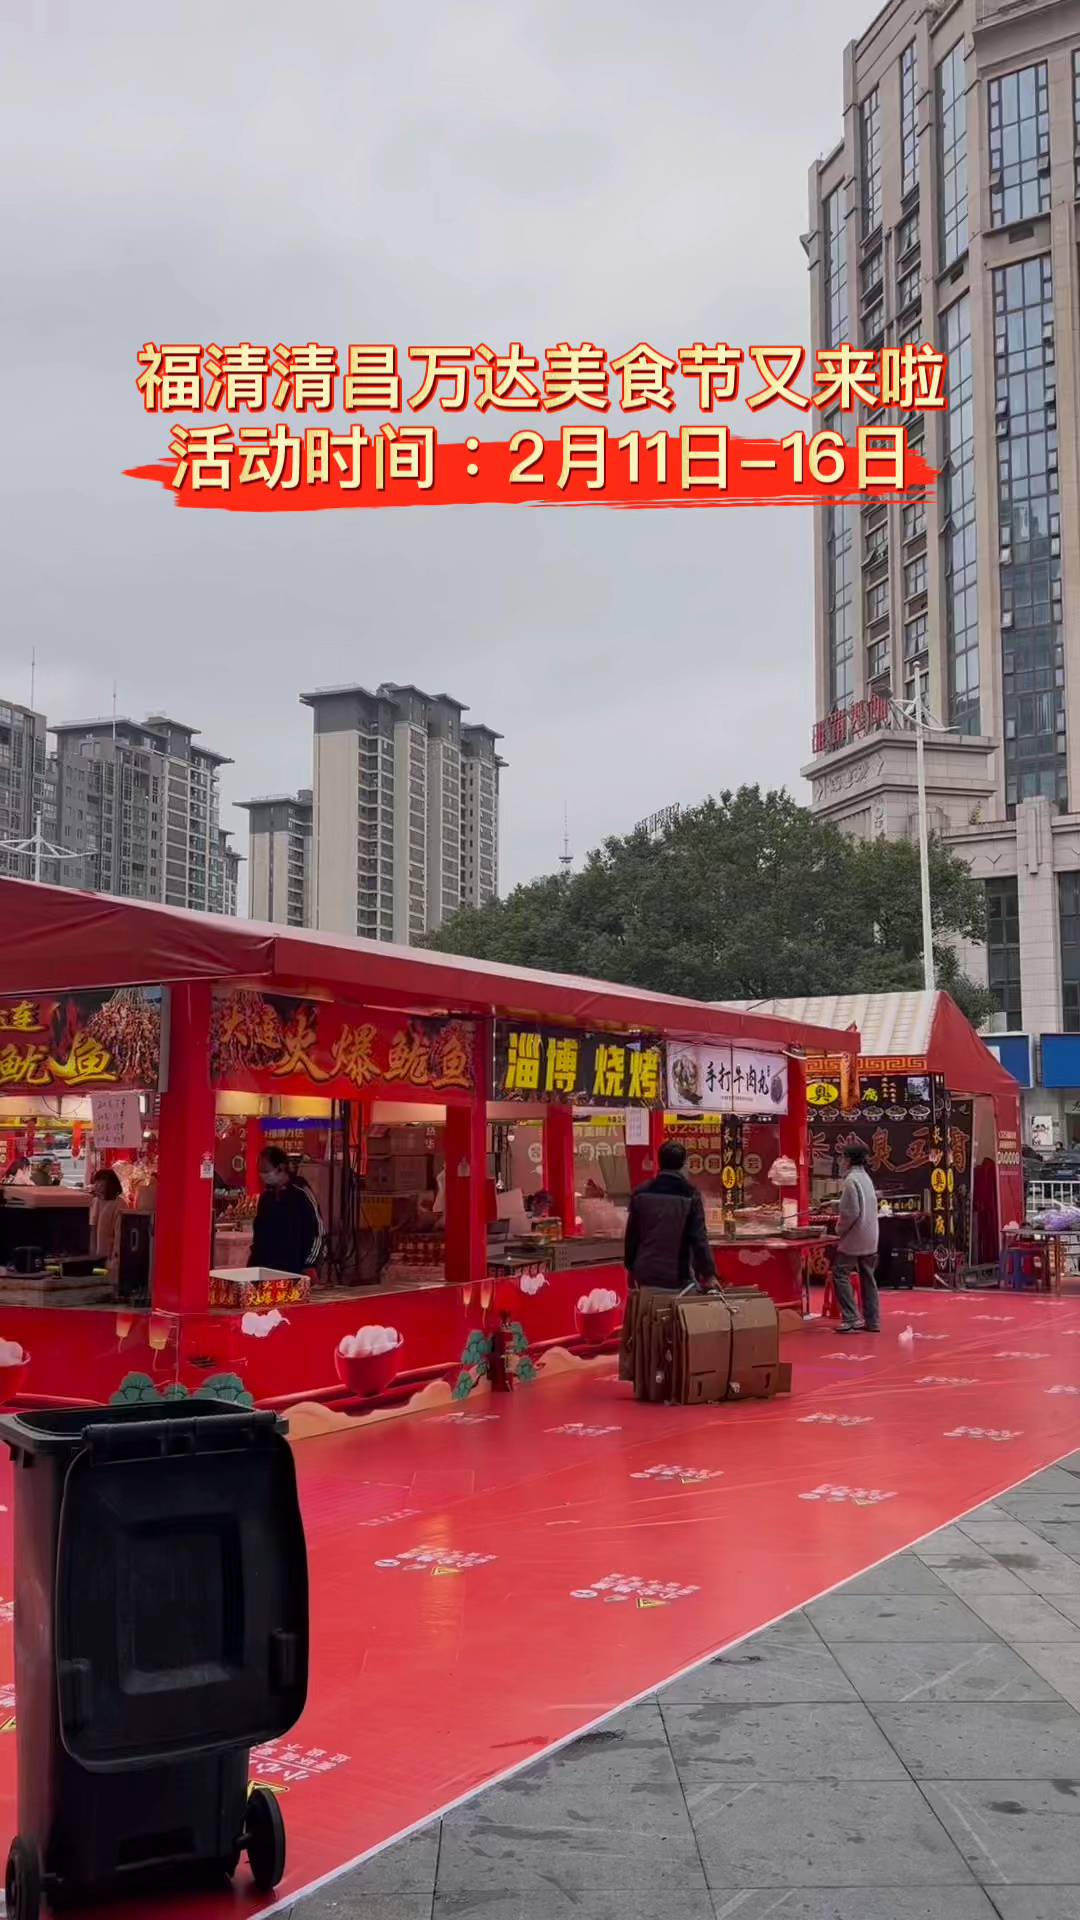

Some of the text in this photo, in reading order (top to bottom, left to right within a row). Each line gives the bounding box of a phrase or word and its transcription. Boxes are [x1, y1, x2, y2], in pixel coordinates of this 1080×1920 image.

[706, 1061, 769, 1095] 手打牛肉丸
